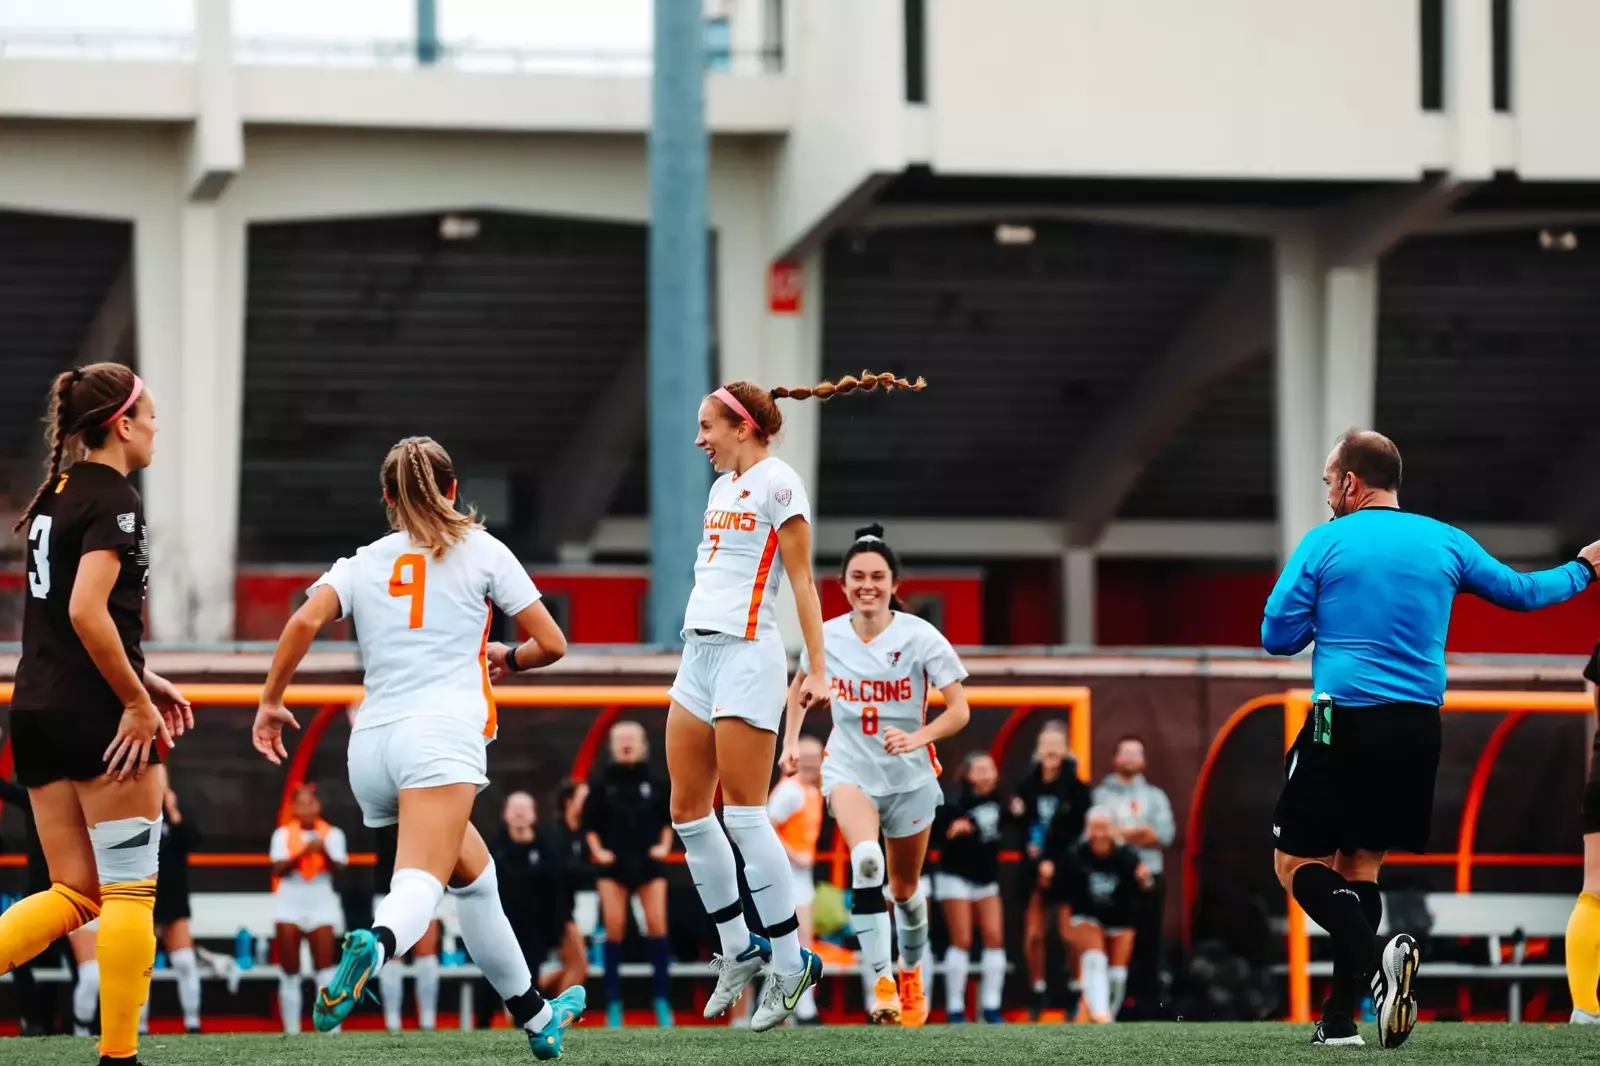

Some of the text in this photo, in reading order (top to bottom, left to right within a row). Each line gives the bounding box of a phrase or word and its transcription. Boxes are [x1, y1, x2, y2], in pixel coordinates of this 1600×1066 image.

[28, 514, 52, 599] 3
[707, 534, 720, 563] 7
[388, 553, 426, 629] 9
[830, 676, 911, 702] FALCONS
[862, 706, 878, 735] 8
